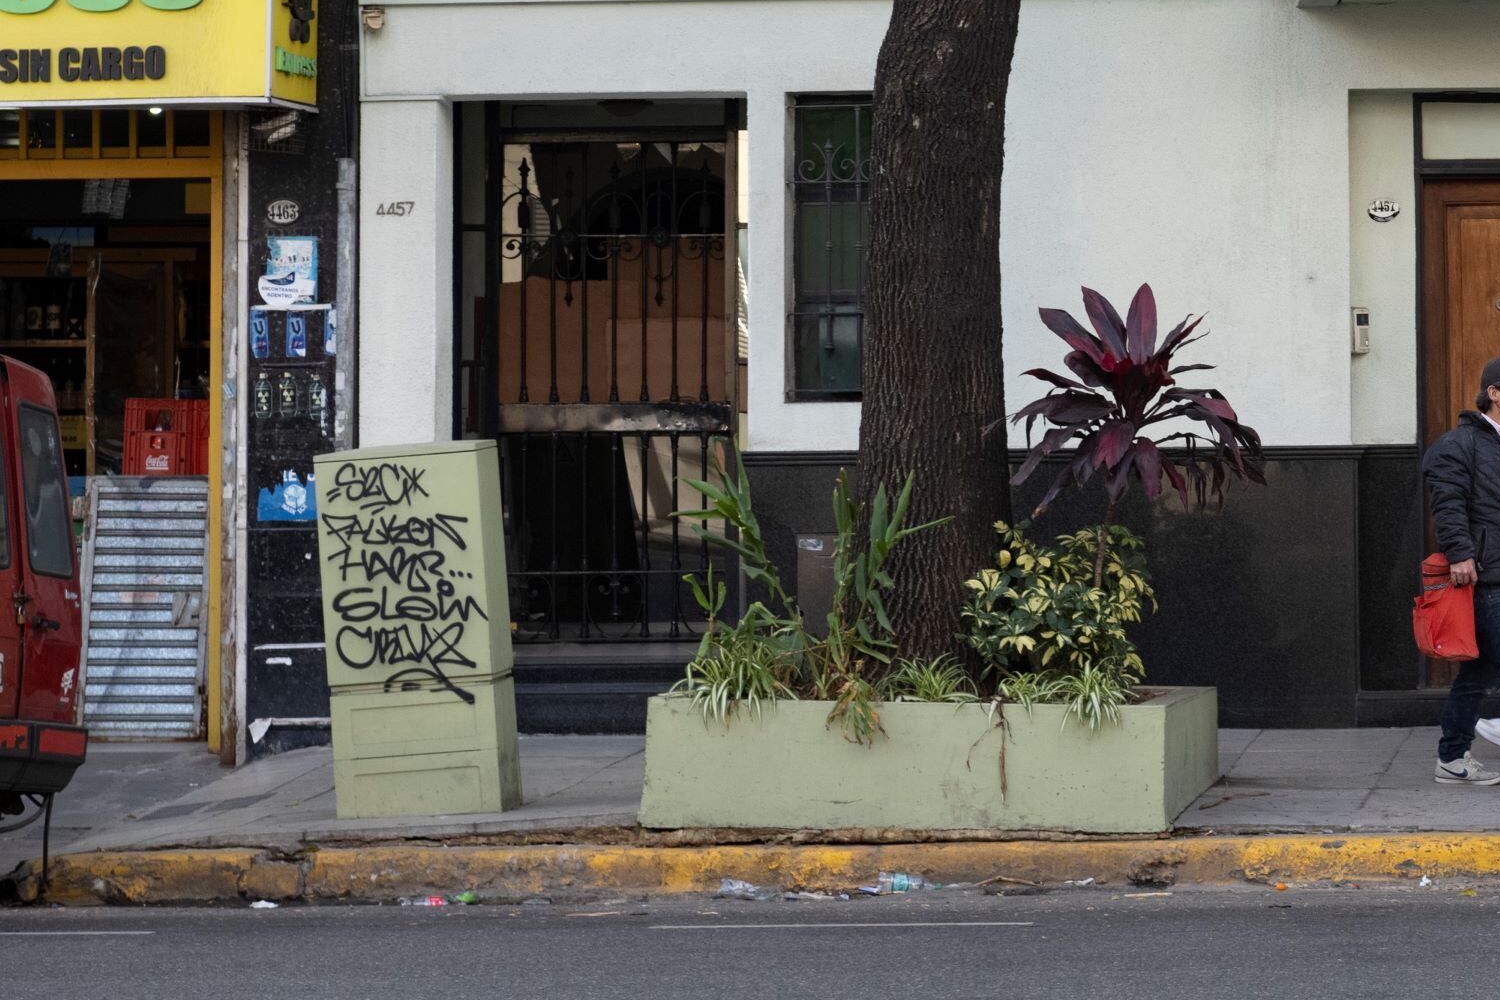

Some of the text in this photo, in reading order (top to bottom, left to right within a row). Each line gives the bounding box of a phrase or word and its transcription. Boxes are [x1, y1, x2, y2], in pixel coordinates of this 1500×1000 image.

[0, 45, 166, 83] SIN CARGO
[270, 205, 297, 220] 4463
[376, 201, 415, 217] 4457
